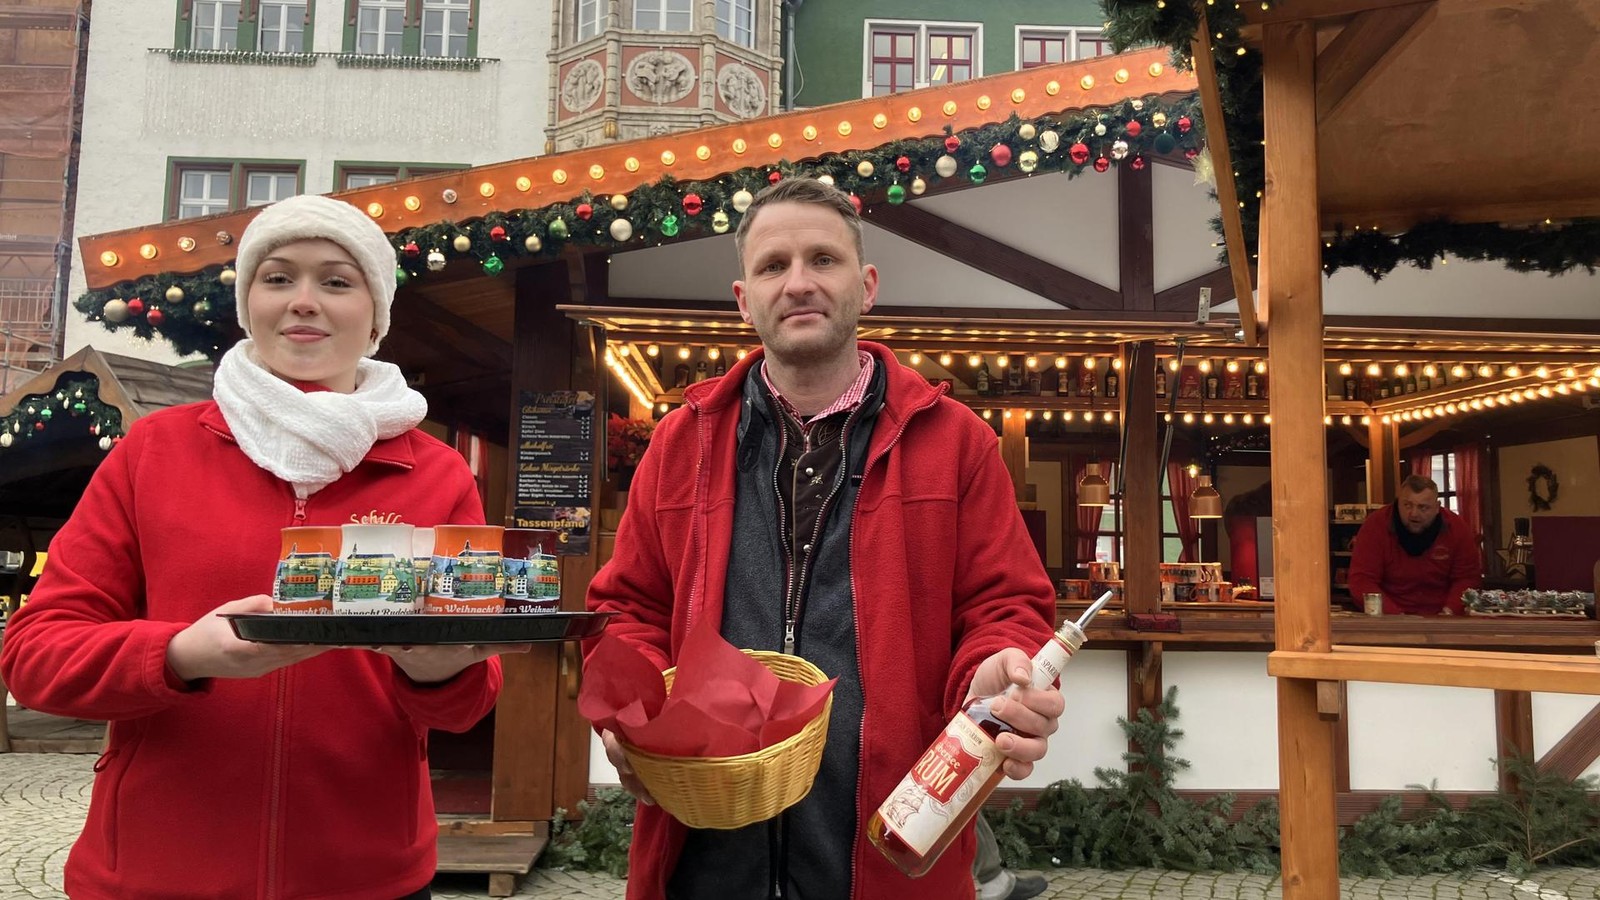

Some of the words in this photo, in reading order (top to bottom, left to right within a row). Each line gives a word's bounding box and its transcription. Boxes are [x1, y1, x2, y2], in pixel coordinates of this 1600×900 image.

[350, 510, 403, 525] Schill
[516, 518, 585, 529] Tassenpfand
[559, 532, 569, 544] €
[444, 604, 494, 613] Weihnacht
[915, 749, 958, 796] RUM
